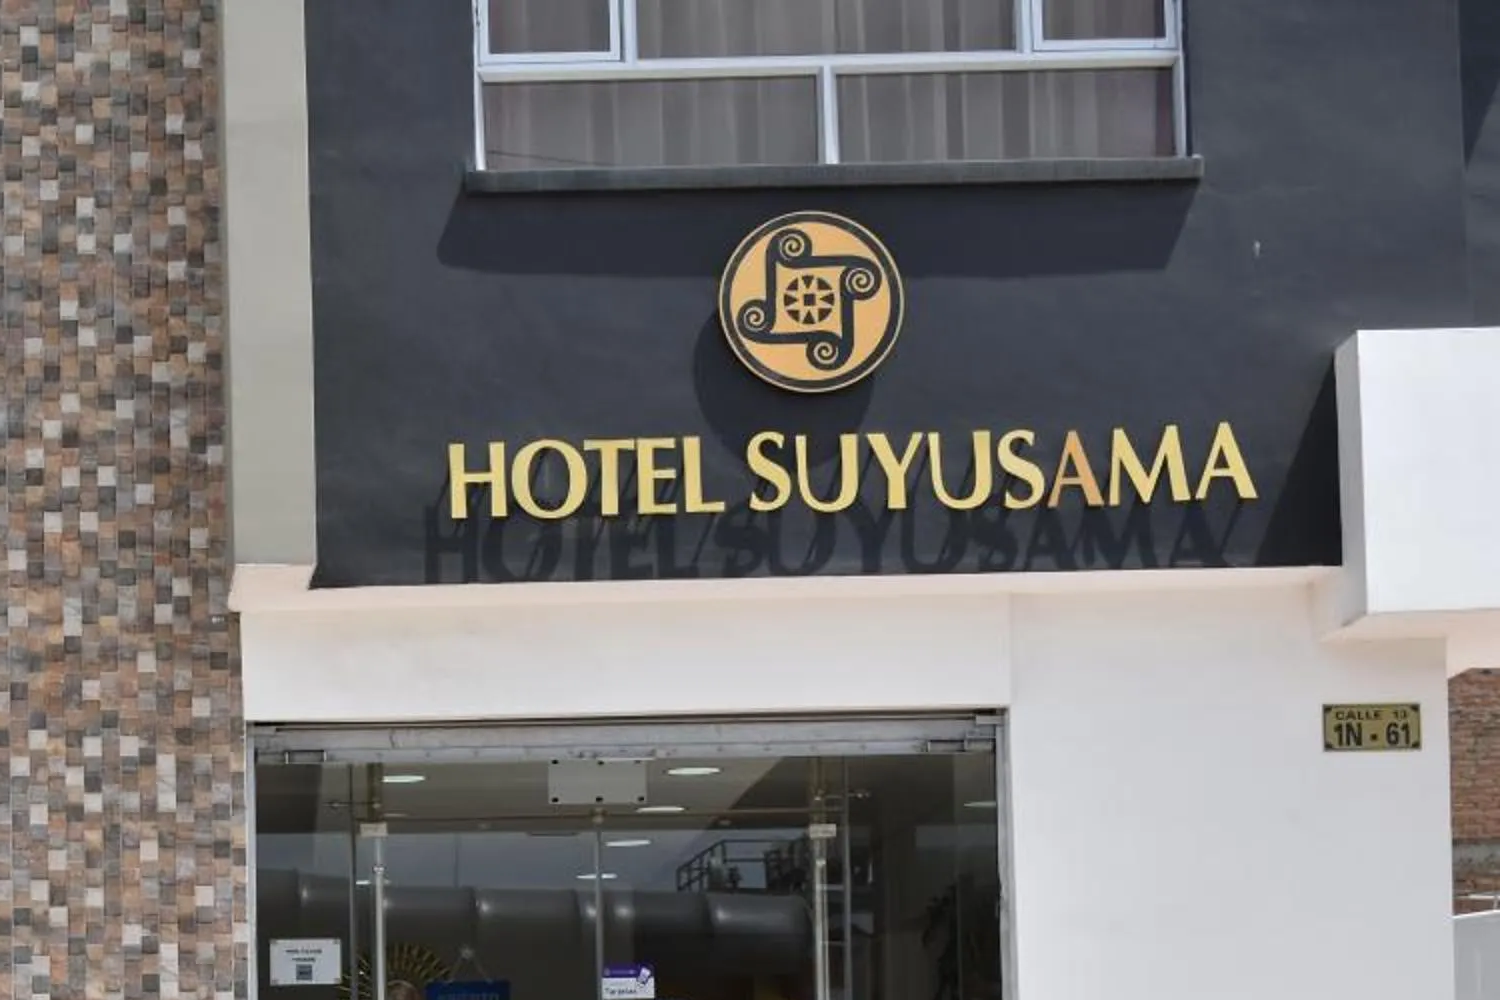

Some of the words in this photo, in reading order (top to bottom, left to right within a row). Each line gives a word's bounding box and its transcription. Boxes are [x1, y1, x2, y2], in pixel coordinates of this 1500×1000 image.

[449, 436, 725, 519] HOTEL
[746, 421, 1258, 512] SUYUSAMA
[1335, 709, 1380, 721] CALLE
[1333, 721, 1363, 747] 1N
[1385, 721, 1411, 746] 61
